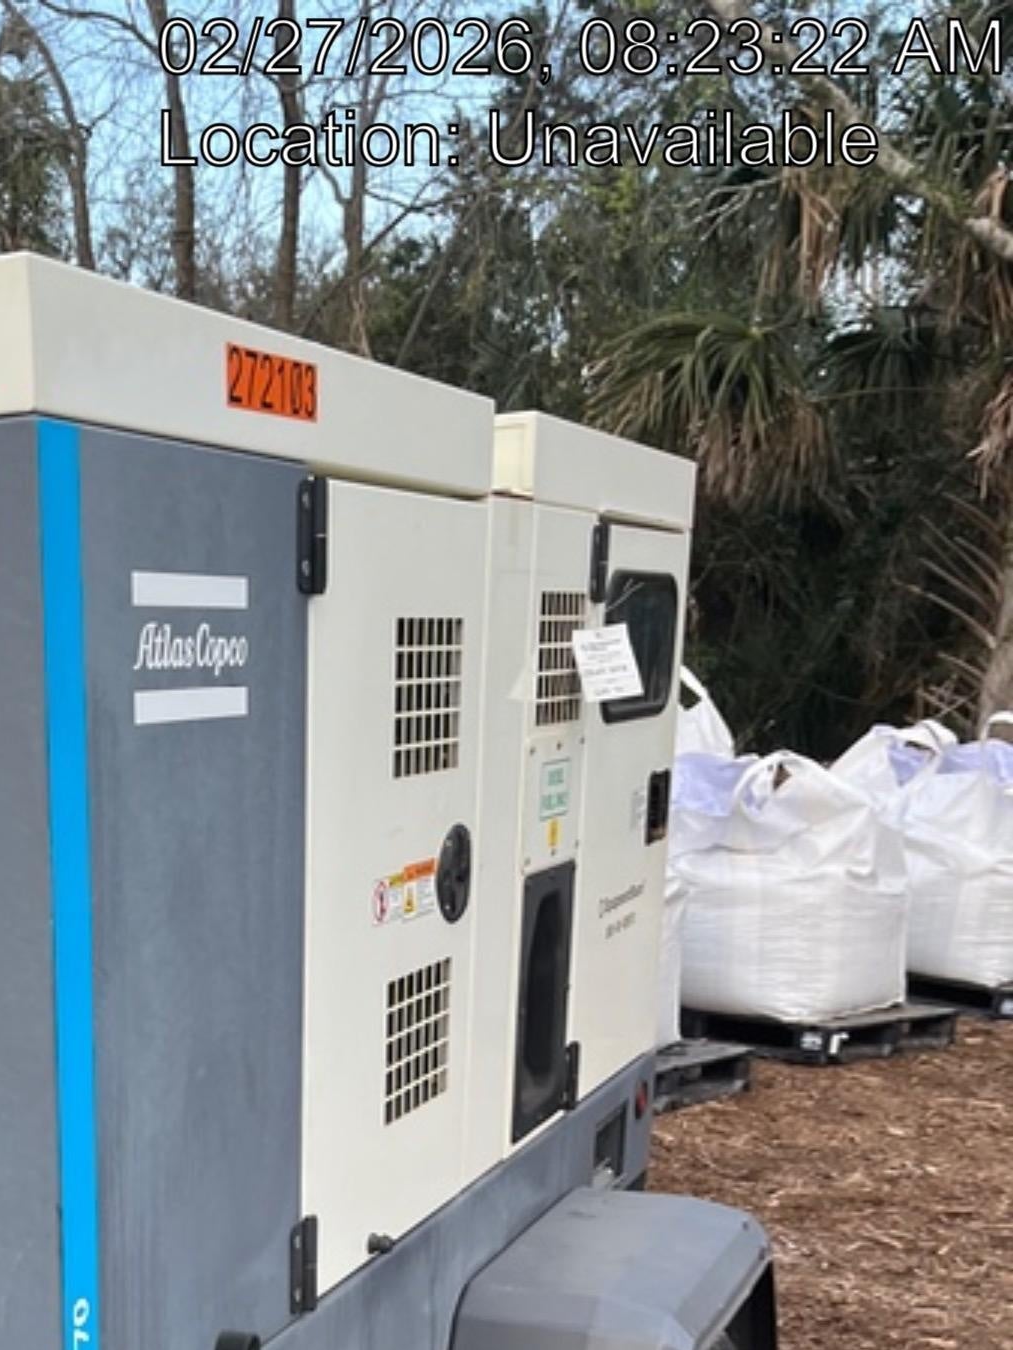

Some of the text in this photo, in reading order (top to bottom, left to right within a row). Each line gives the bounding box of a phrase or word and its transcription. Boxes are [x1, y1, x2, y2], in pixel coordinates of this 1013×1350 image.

[228, 345, 318, 418] 272103
[132, 620, 250, 677] Atlas Copco
